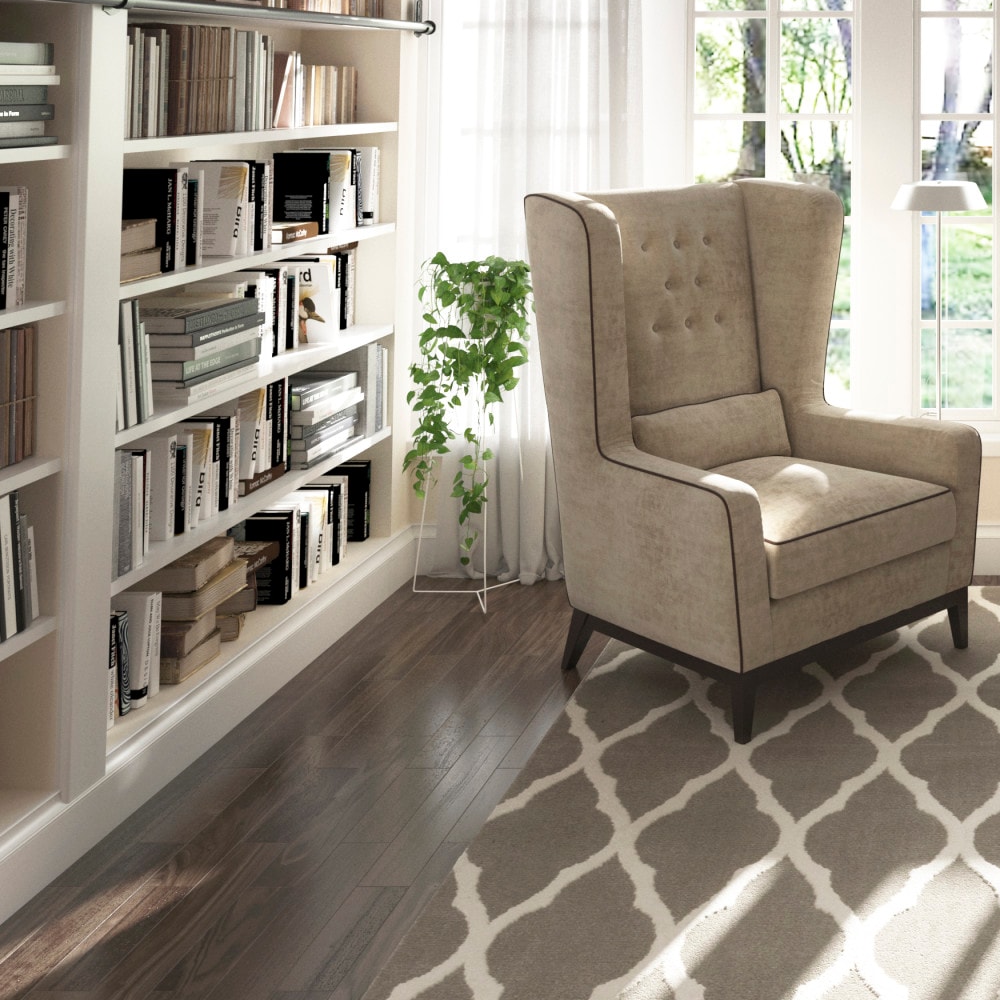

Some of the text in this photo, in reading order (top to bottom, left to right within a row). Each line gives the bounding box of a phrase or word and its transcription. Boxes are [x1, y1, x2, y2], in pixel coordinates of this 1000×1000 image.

[8, 208, 17, 248] Decorating
[186, 357, 221, 374] LIFE AT THE EDGE
